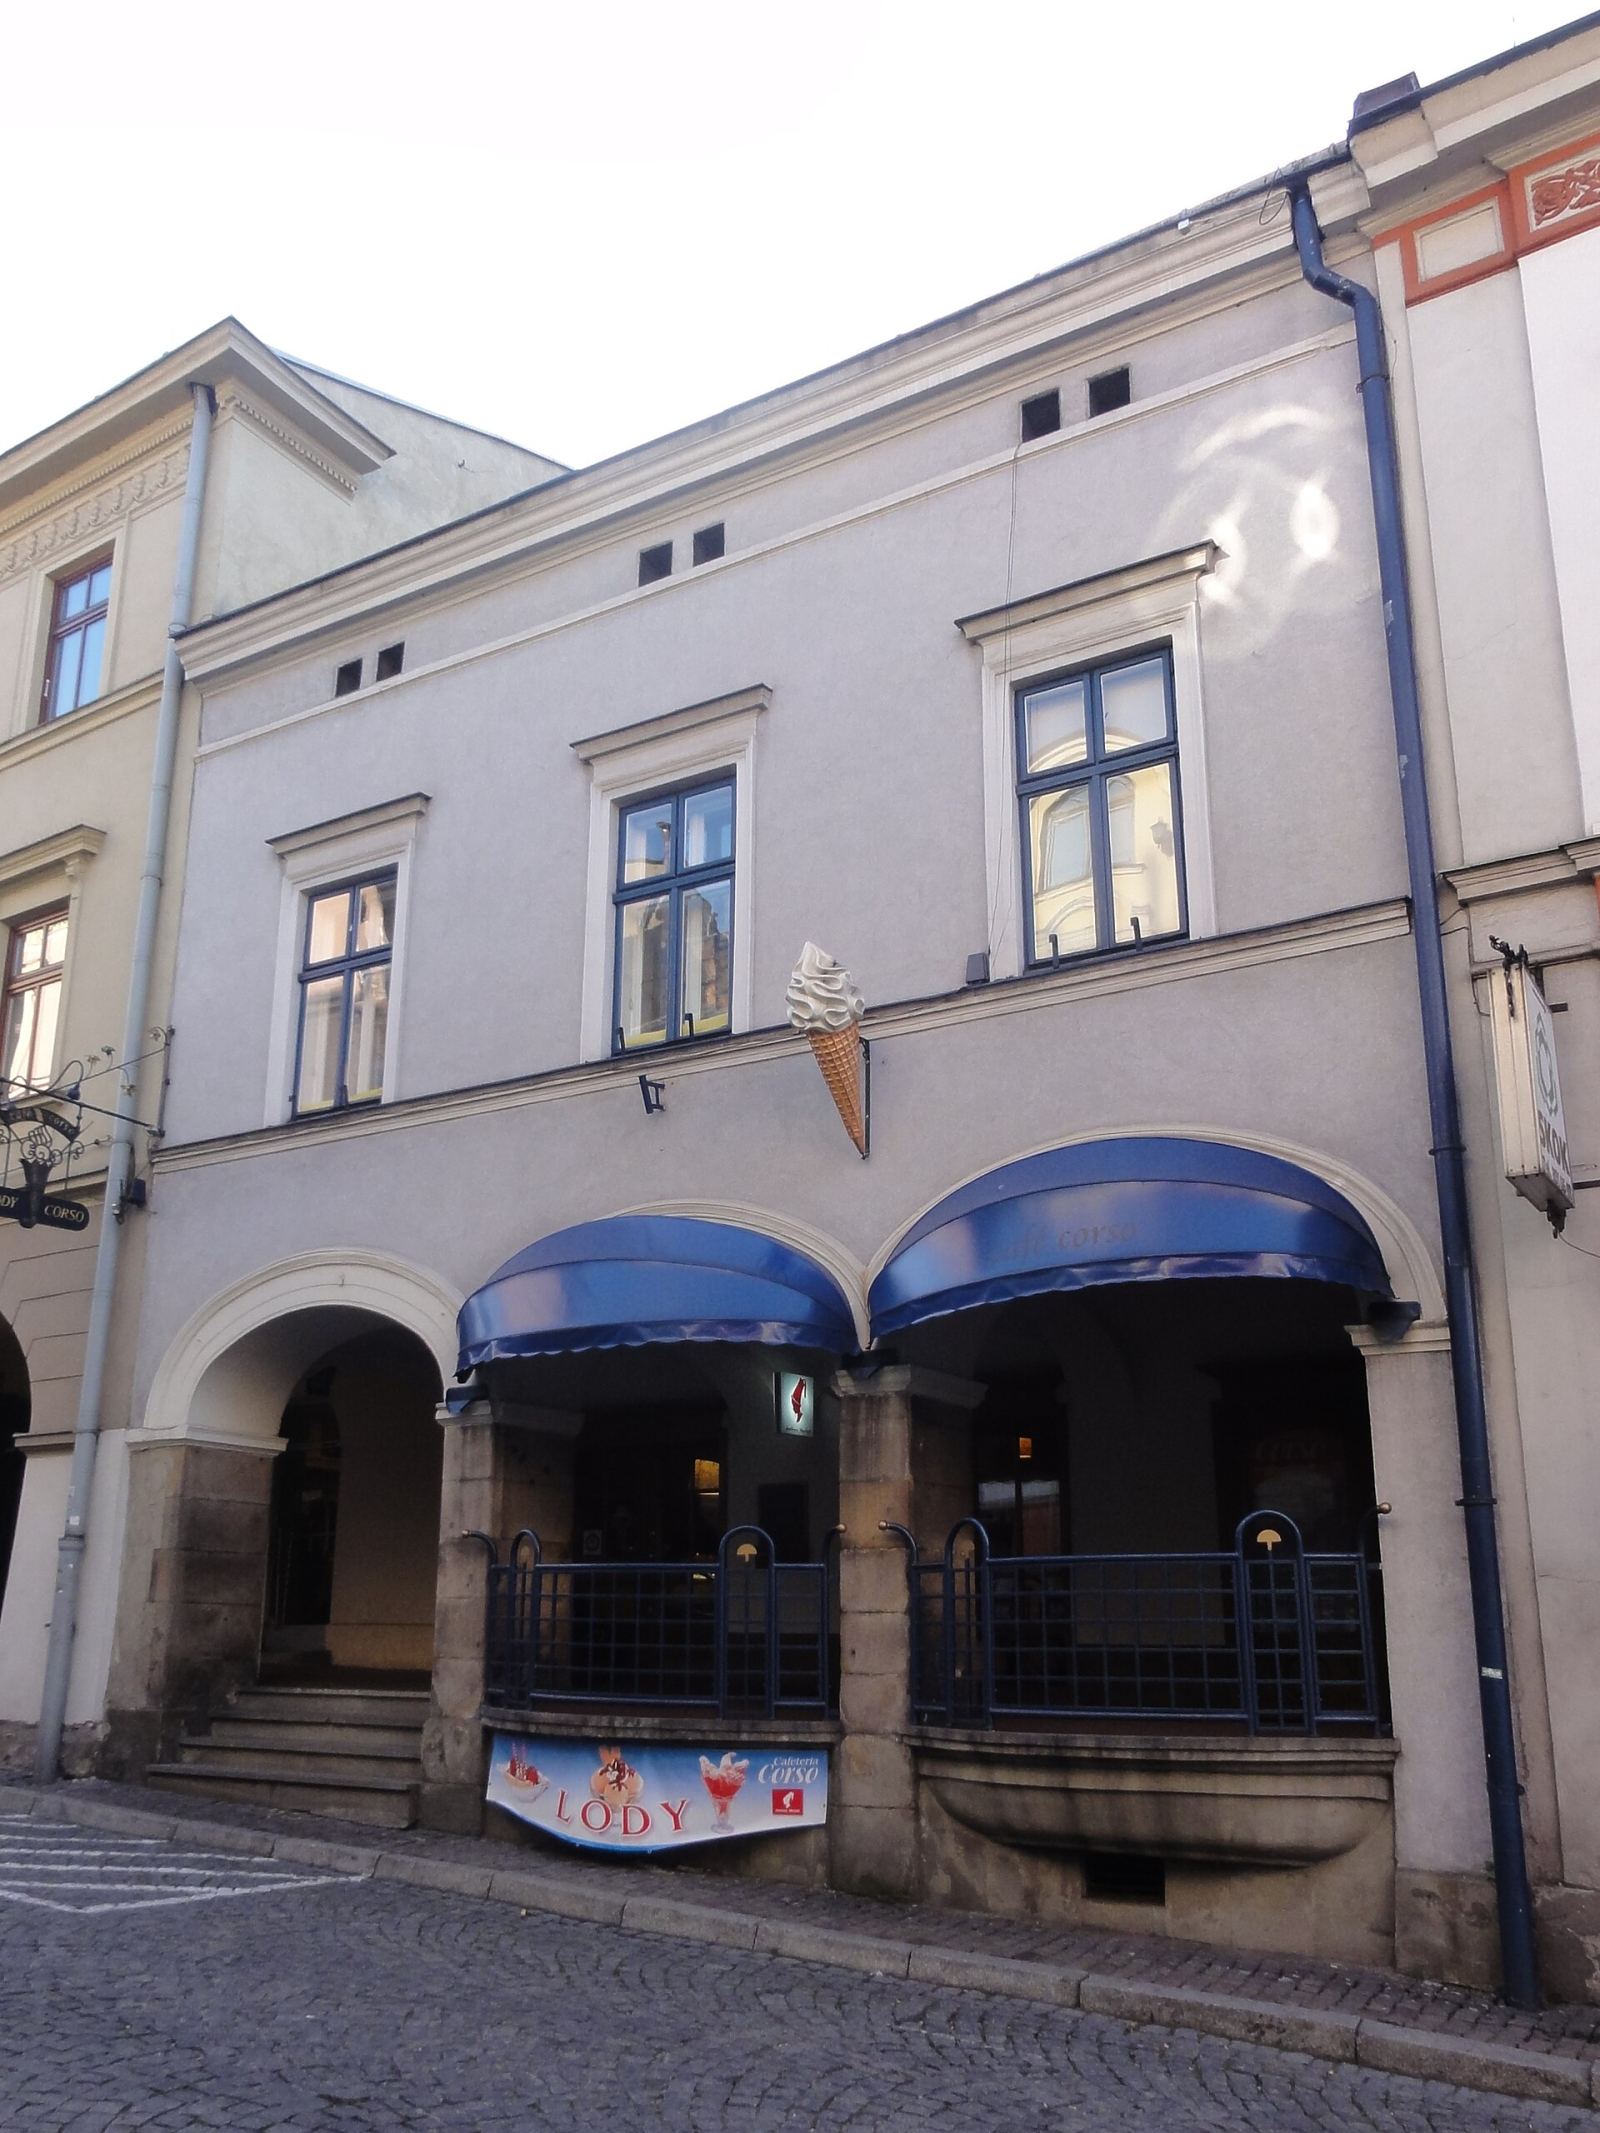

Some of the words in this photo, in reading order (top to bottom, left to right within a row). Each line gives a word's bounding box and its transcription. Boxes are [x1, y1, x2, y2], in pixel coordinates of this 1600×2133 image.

[1537, 1110, 1571, 1177] SKOK
[0, 1194, 19, 1208] DY
[44, 1205, 85, 1223] CORSO
[1058, 1222, 1137, 1250] corso
[758, 1764, 819, 1784] Corso
[772, 1756, 819, 1767] Cafeteria
[554, 1788, 689, 1837] LODY
